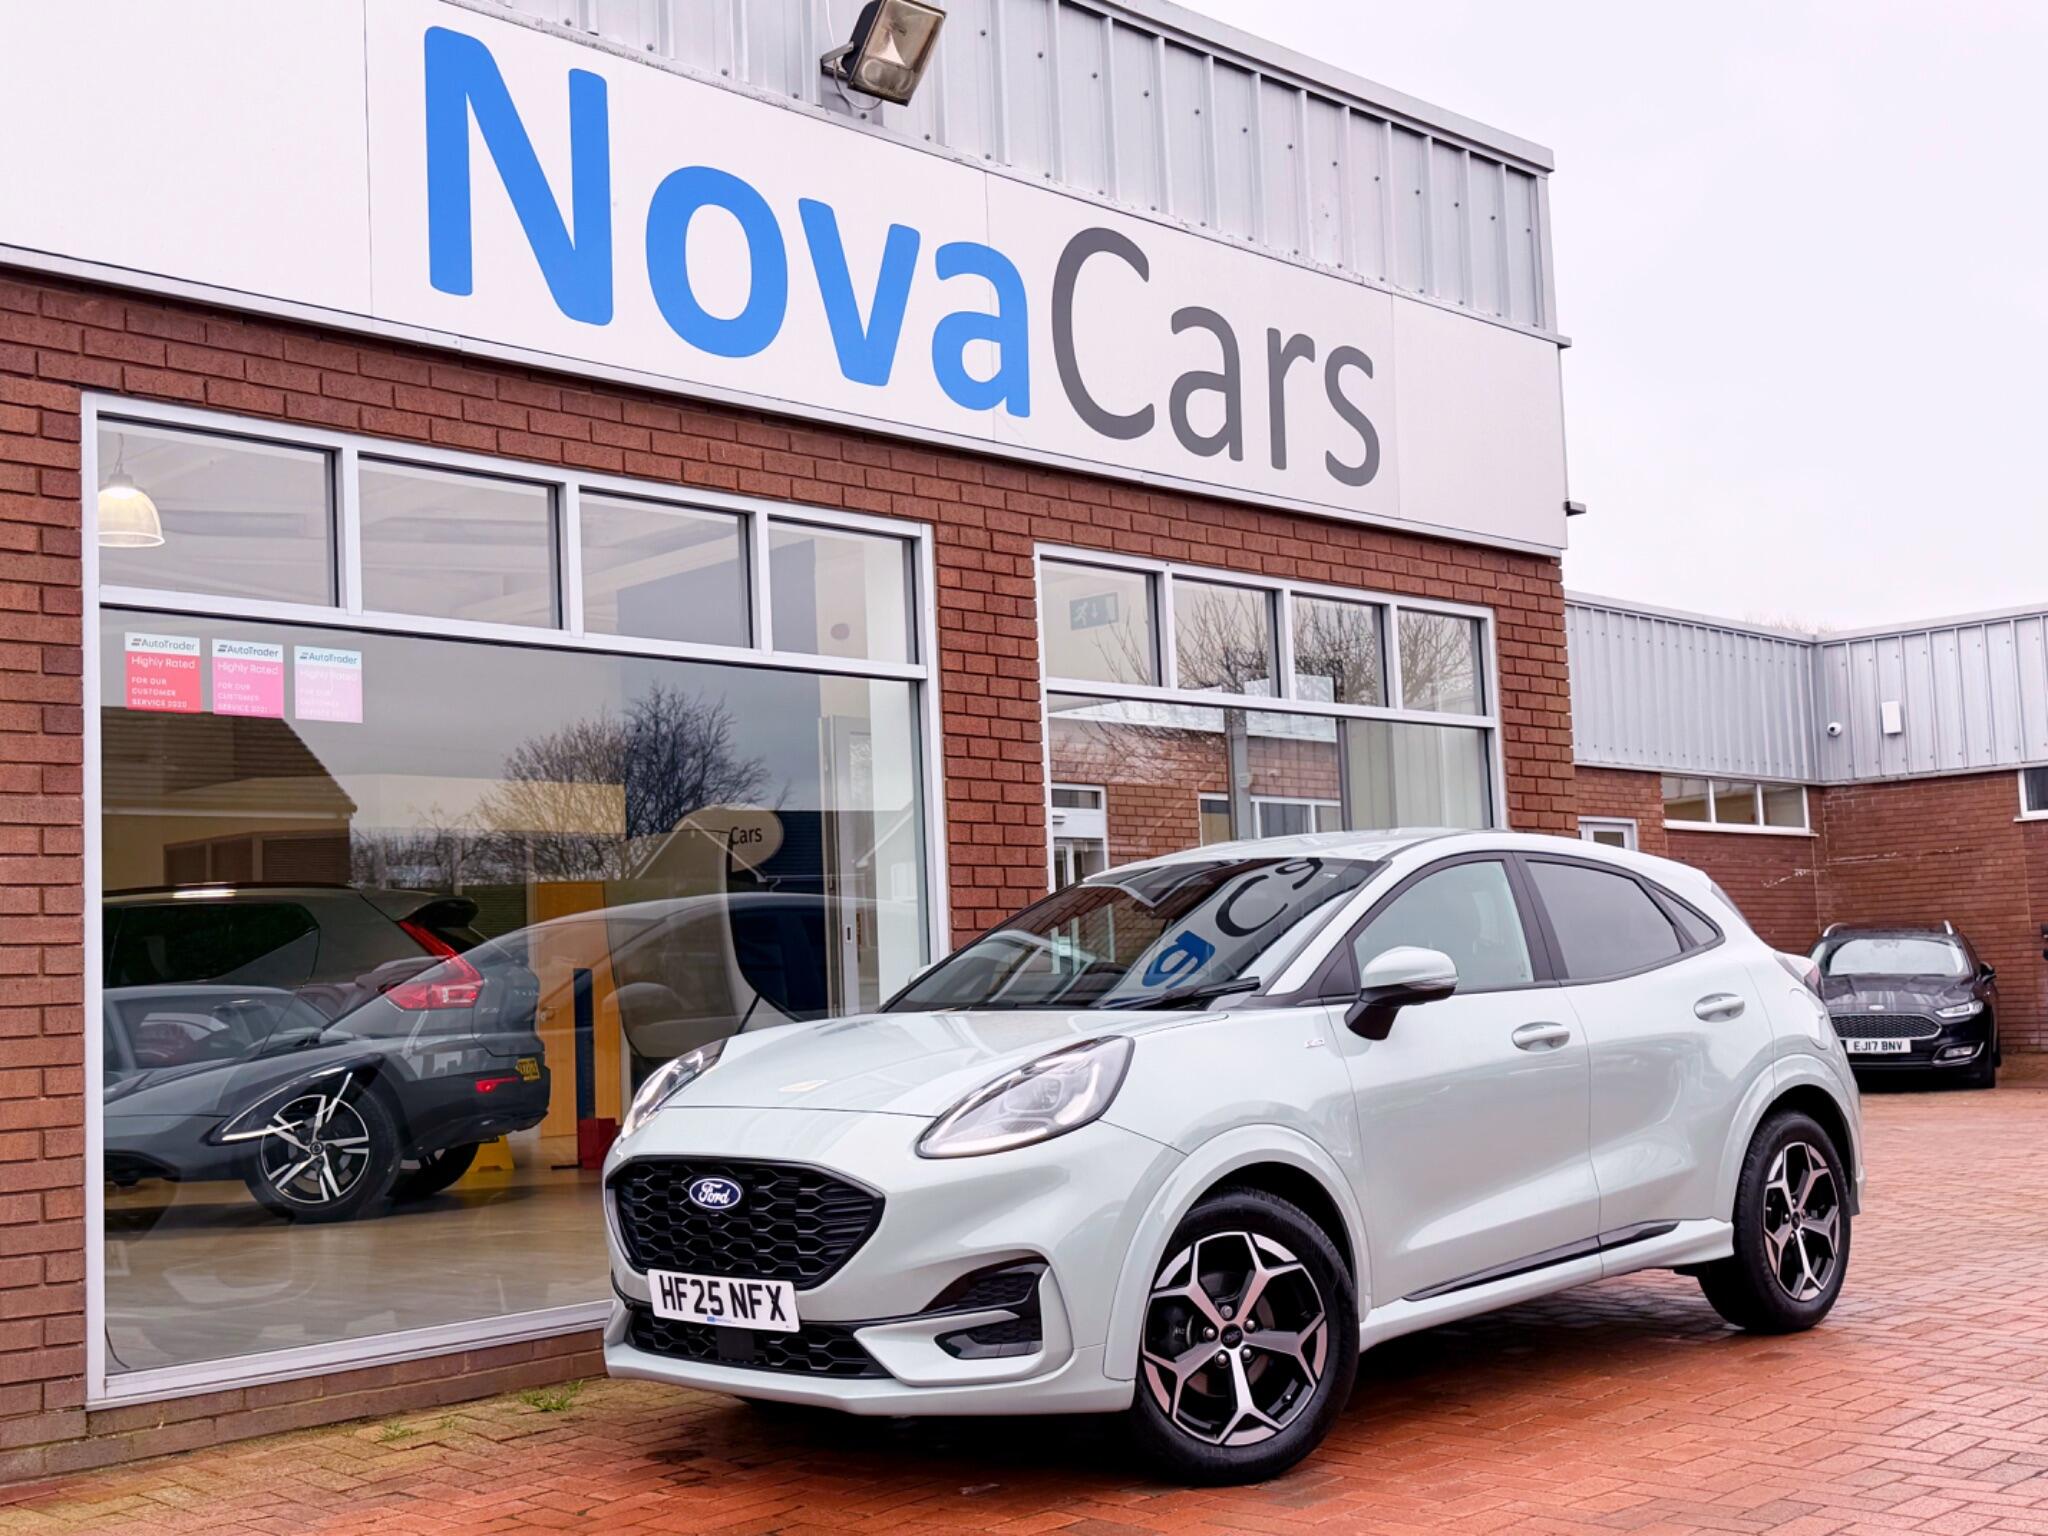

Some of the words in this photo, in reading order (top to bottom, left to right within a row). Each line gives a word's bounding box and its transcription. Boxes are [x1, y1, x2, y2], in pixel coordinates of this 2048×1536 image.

[424, 26, 1380, 486] NovaCars
[141, 638, 195, 651] AutoTrader
[227, 645, 279, 657] AutoTrader
[131, 655, 164, 669] Highly
[166, 658, 196, 669] Rated
[309, 651, 358, 664] AutoTrader
[131, 676, 148, 685] FOR
[150, 678, 167, 686] OUR
[131, 687, 176, 697] CUSTOMER
[1853, 1041, 1878, 1051] EJ17
[1881, 1041, 1903, 1051] BNV
[698, 1181, 731, 1204] Ford
[658, 1274, 724, 1316] HF25
[728, 1282, 786, 1322] NFX
